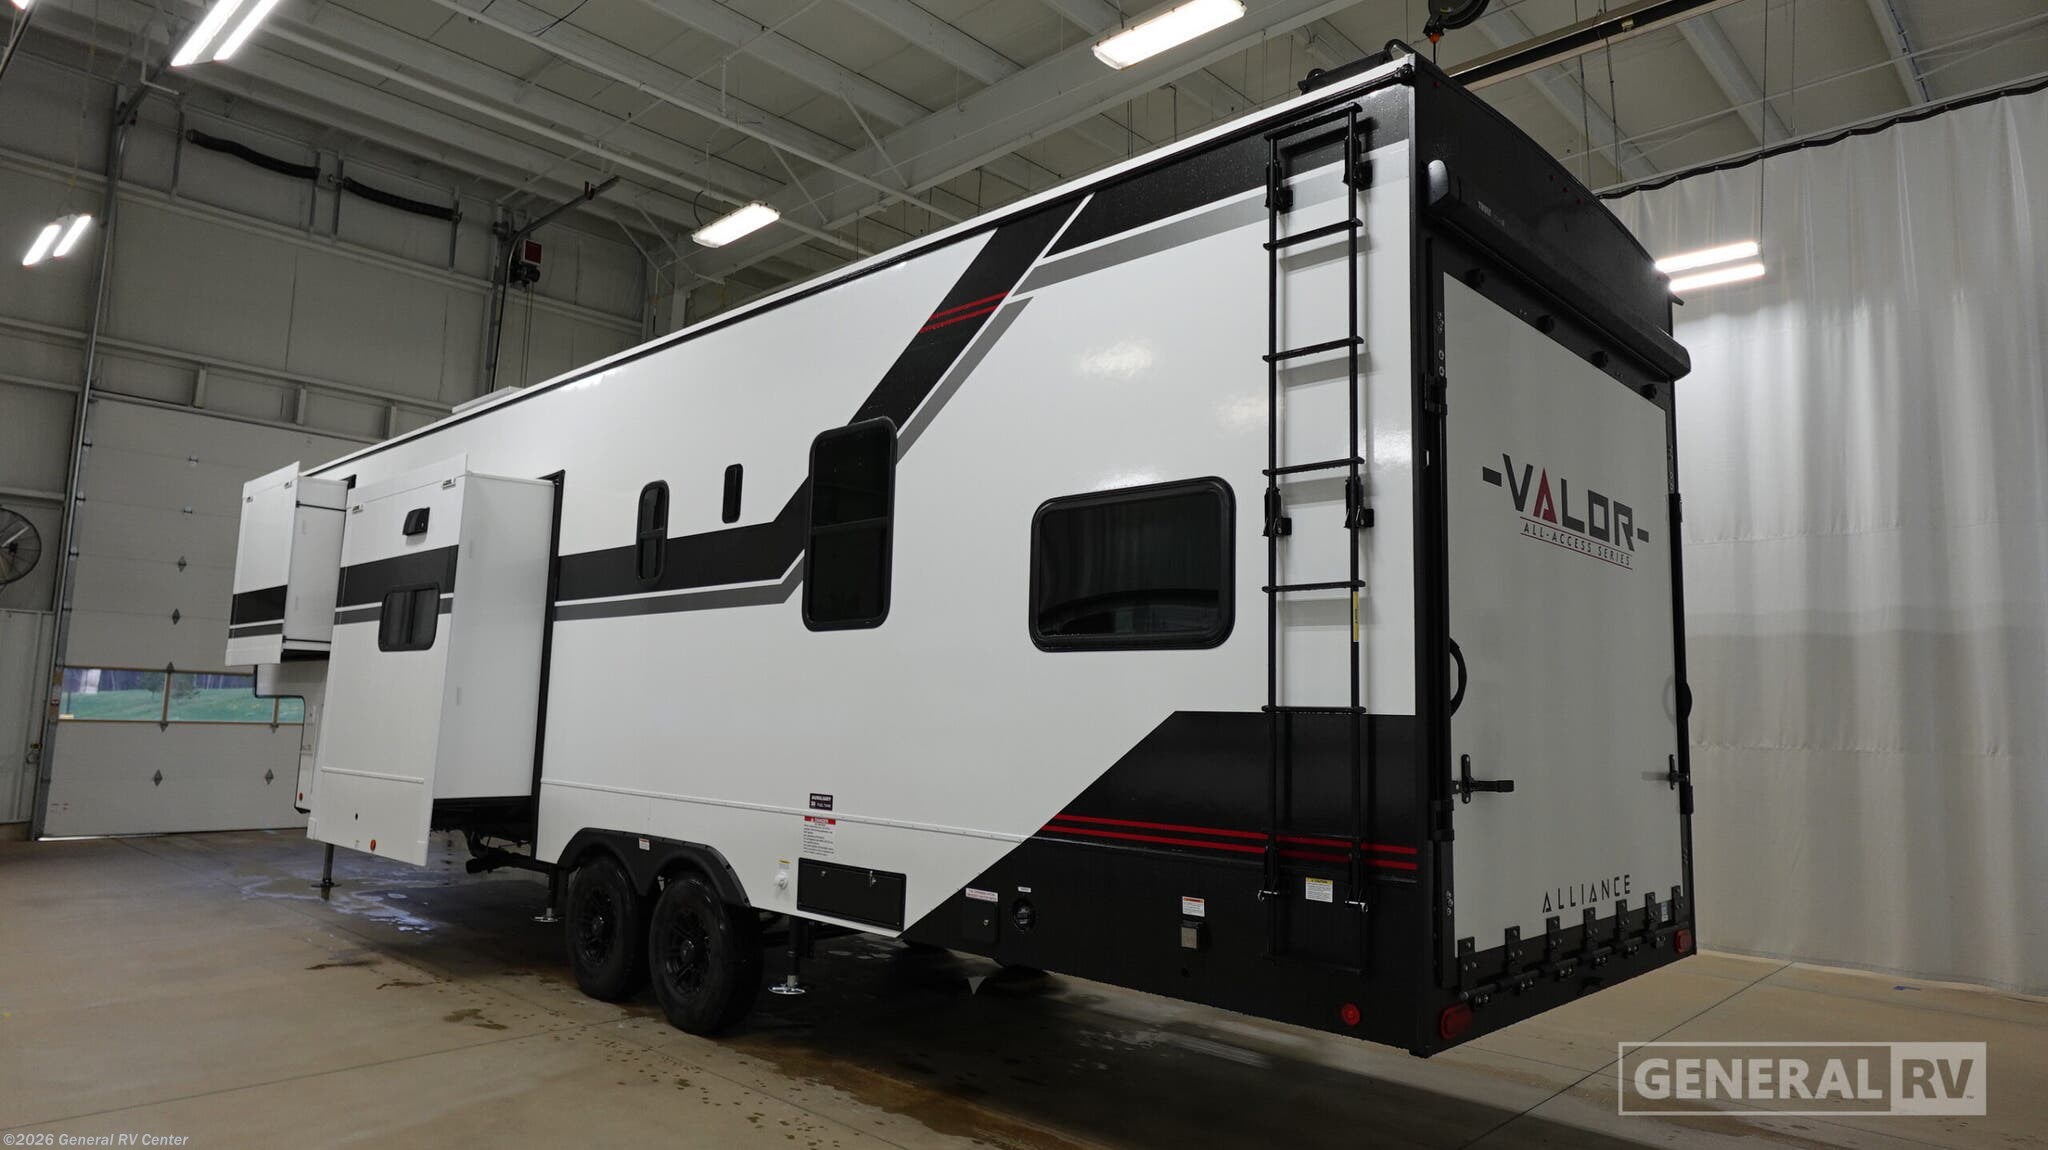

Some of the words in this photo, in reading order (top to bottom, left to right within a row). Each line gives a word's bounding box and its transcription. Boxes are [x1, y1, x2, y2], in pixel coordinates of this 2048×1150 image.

[1523, 522, 1593, 553] ALL-ACCESS
[1598, 546, 1631, 566] SERIES
[1543, 874, 1630, 913] ALLIANCE
